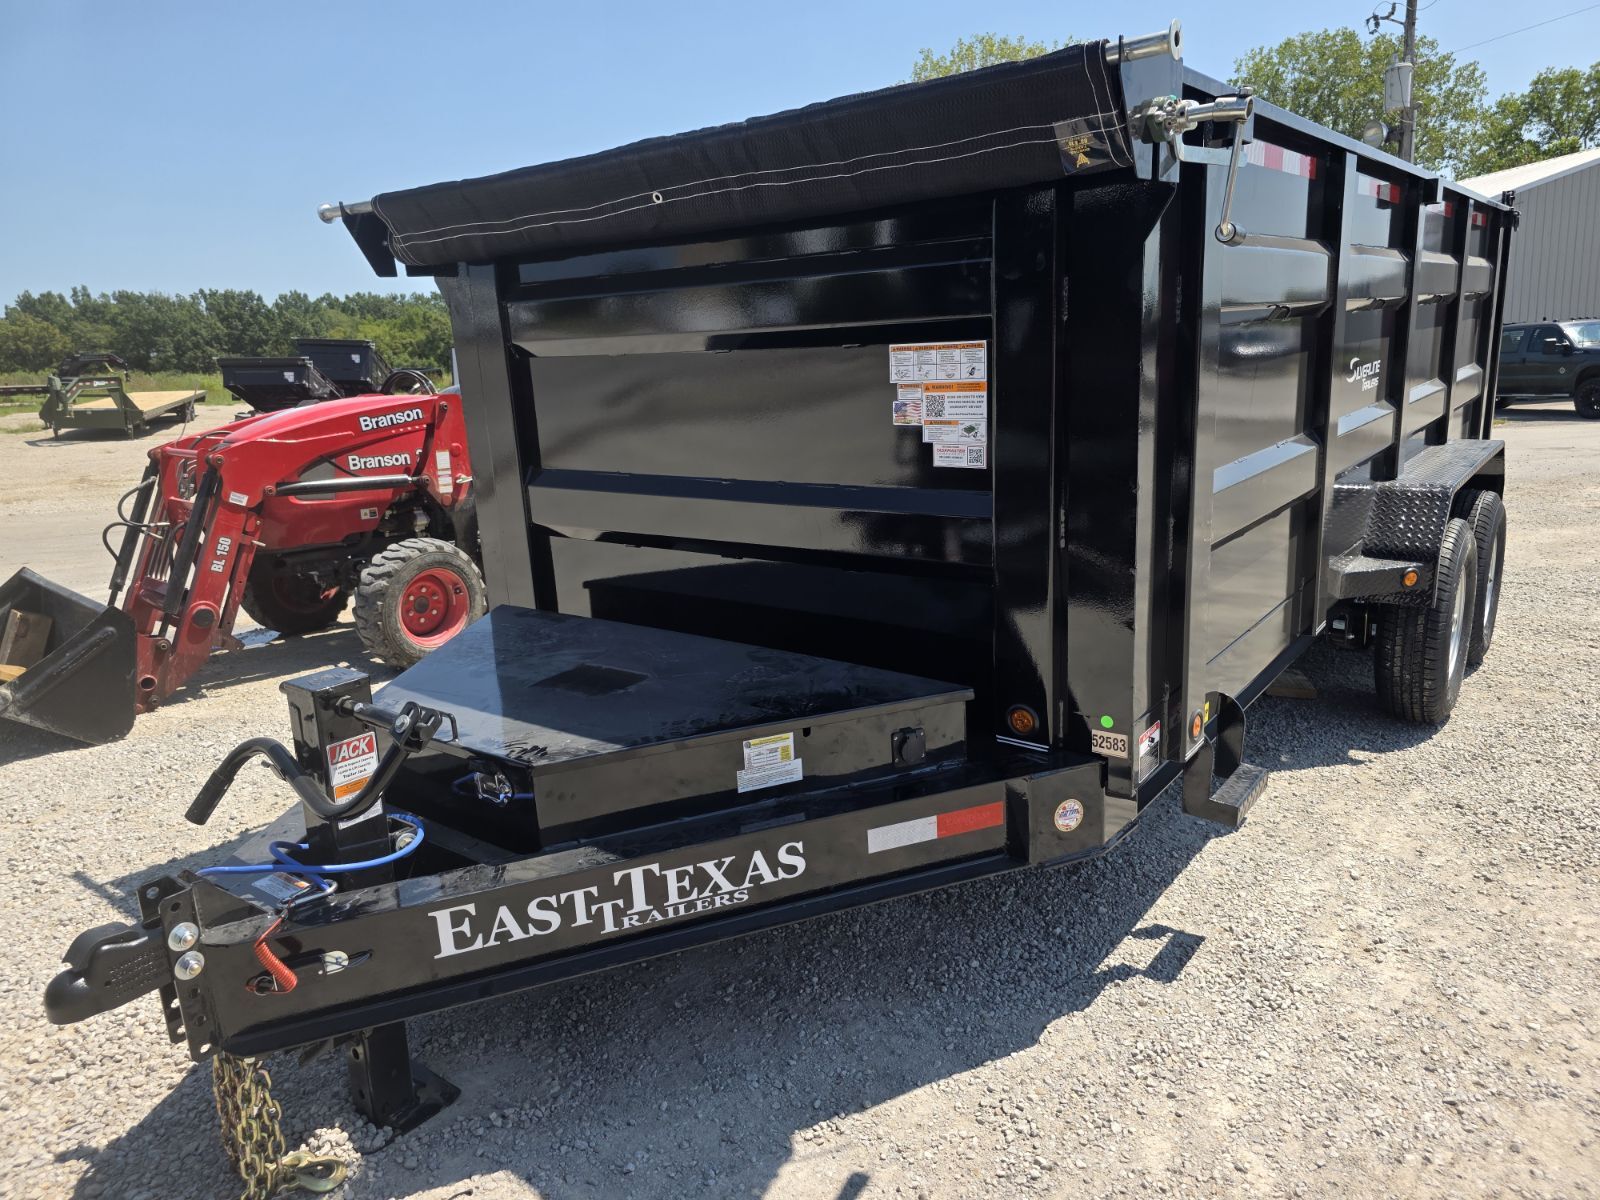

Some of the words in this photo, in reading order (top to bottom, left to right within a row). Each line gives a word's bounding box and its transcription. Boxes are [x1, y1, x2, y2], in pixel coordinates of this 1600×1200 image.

[359, 408, 423, 432] Branson
[348, 453, 411, 471] Branson
[216, 536, 232, 556] 150
[211, 559, 226, 573] BL
[332, 736, 370, 763] JACK
[1092, 734, 1126, 753] 52583
[428, 885, 604, 960] EAST
[613, 841, 806, 916] TEXAS
[591, 889, 749, 935] TRAILERS
